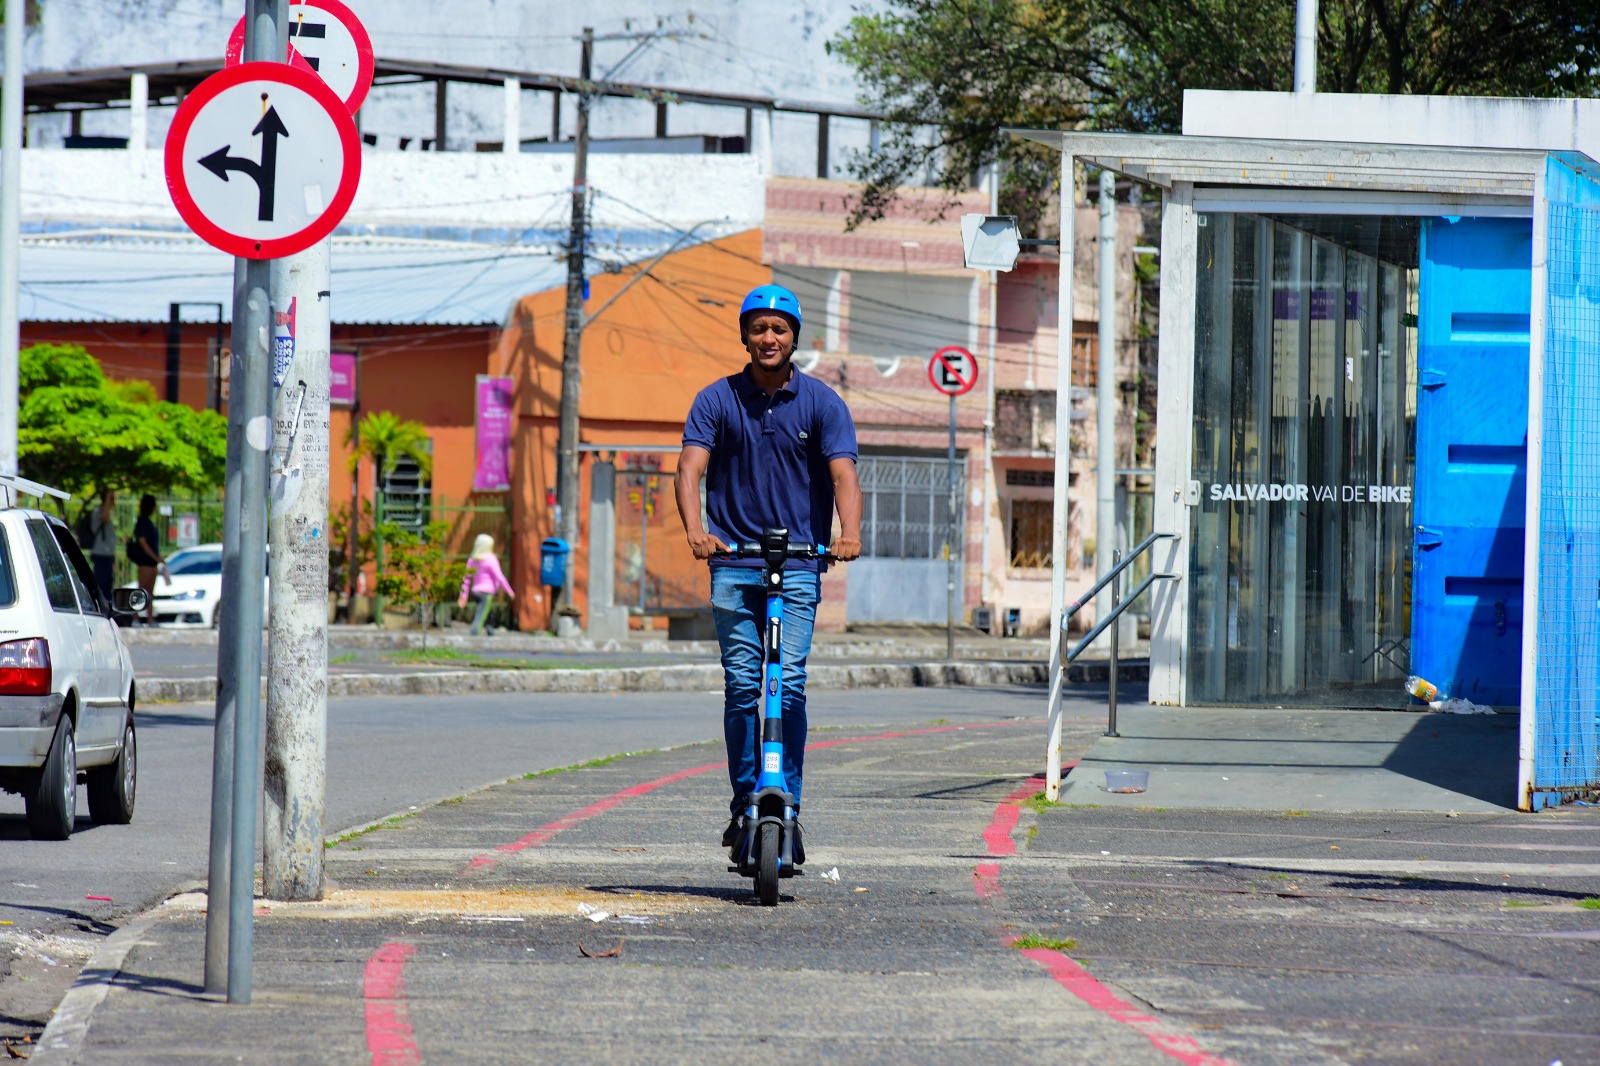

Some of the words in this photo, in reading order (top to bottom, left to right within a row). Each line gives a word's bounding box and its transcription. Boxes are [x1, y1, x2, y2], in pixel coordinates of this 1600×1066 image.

[942, 355, 962, 386] E
[1210, 484, 1309, 501] SALVADOR
[1312, 485, 1337, 502] VAI
[1342, 485, 1365, 503] DE
[1369, 485, 1412, 503] BIKE
